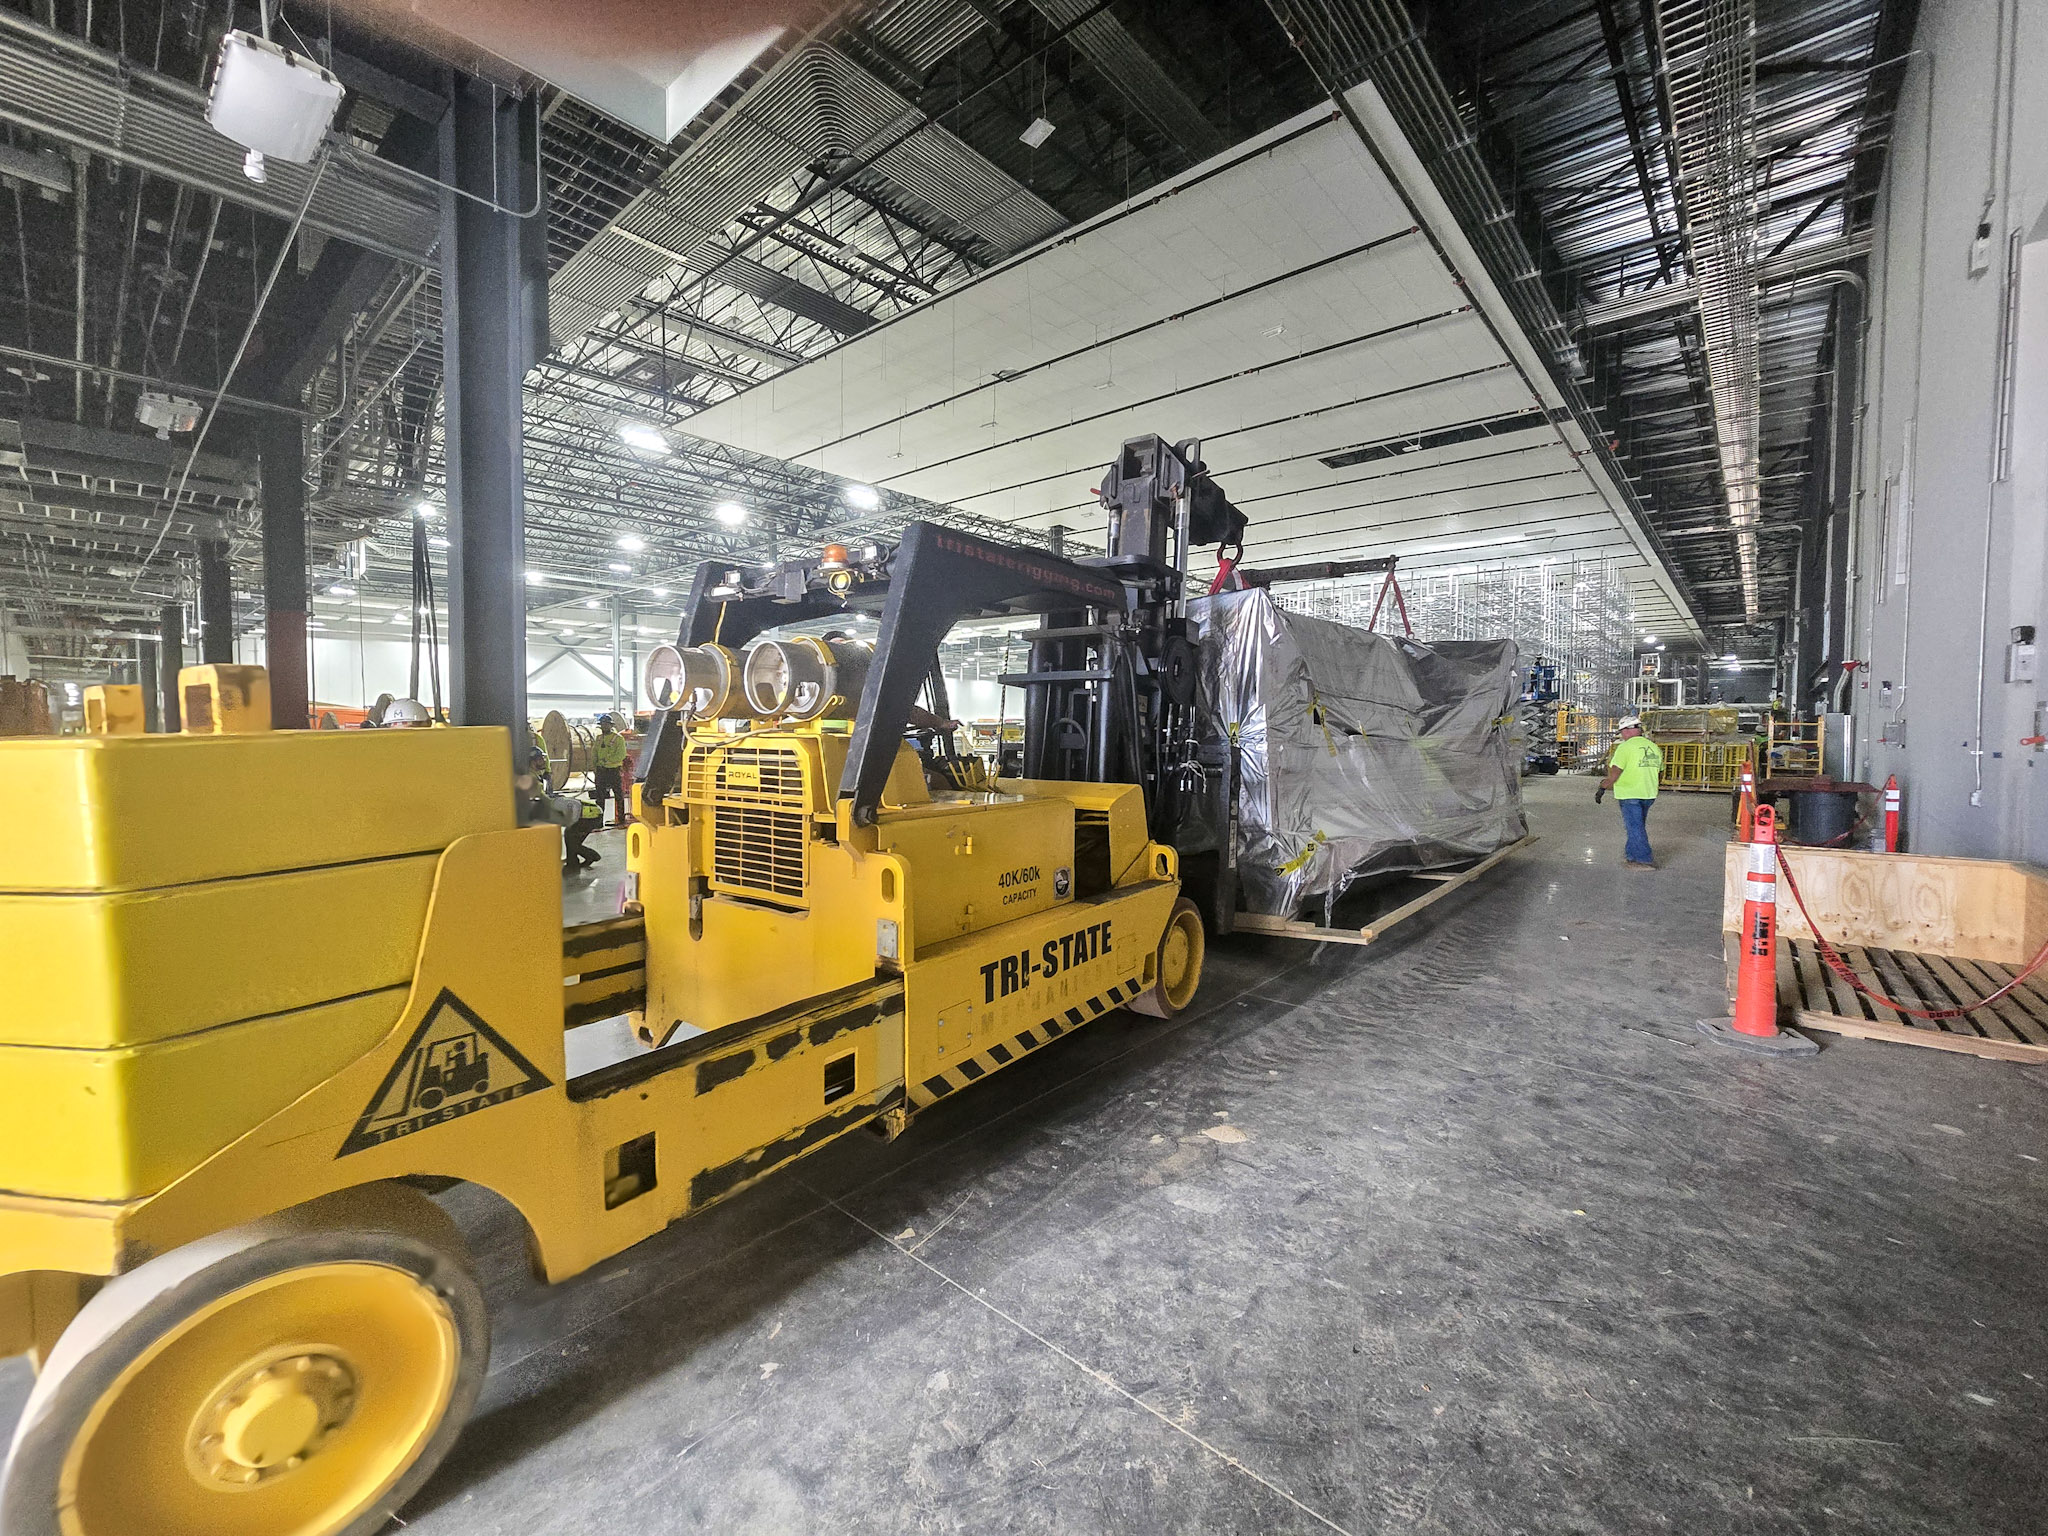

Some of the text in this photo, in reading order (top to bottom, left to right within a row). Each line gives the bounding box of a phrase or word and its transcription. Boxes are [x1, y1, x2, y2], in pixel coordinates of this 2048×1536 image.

[728, 771, 757, 779] ROYAL
[998, 865, 1041, 889] 40K/60k
[1002, 887, 1037, 906] CAPACITY
[980, 920, 1112, 1004] TRI-STATE
[374, 1084, 526, 1143] TRI-STATE
